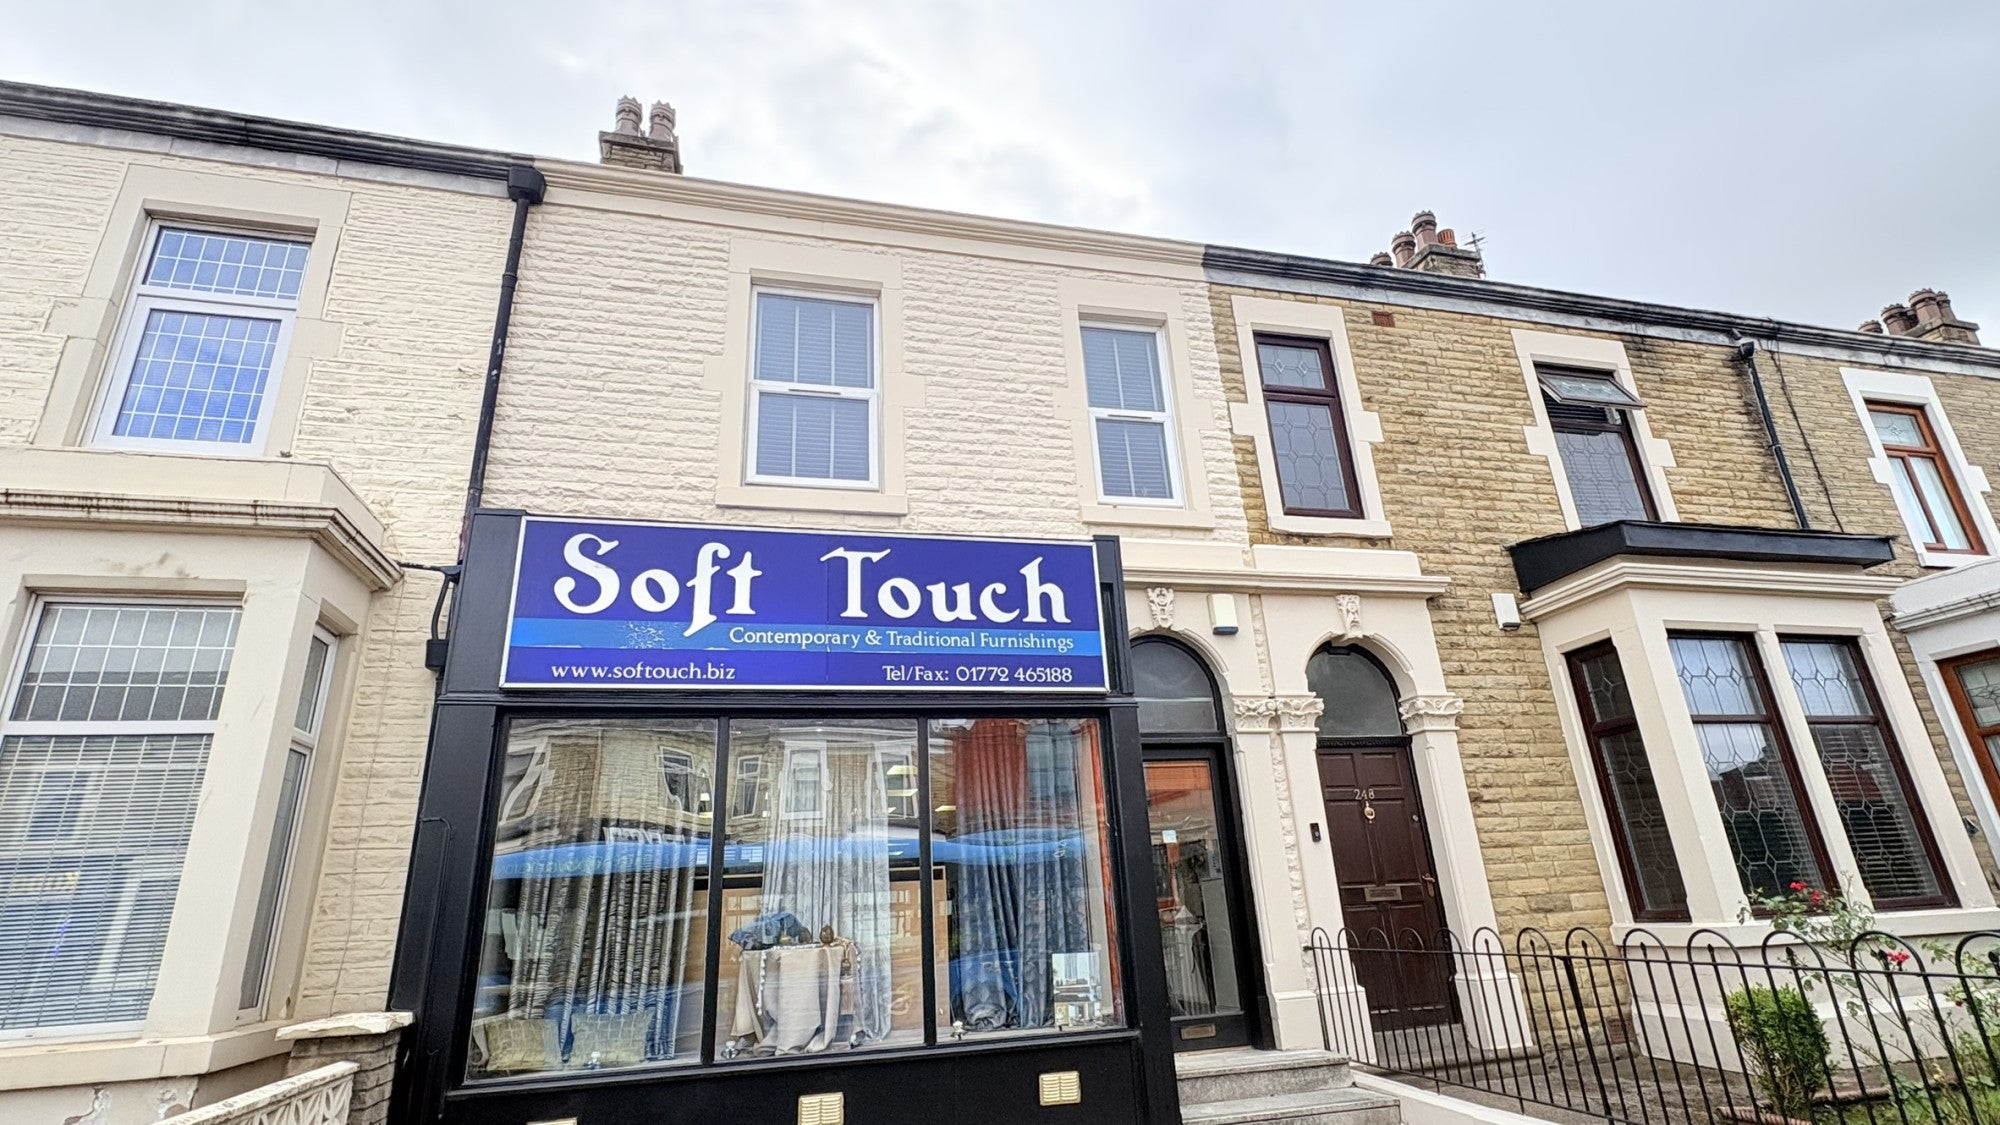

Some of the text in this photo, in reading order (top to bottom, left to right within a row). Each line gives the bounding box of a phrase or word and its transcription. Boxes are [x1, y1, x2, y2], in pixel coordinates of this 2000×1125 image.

[553, 532, 1073, 638] Soft Touch
[728, 626, 1075, 654] Contemporary & Traditional Furnishings
[551, 662, 736, 680] www.softouch.biz
[881, 664, 1074, 684] Tel/Fax: 01772 465188
[1354, 788, 1375, 800] 248
